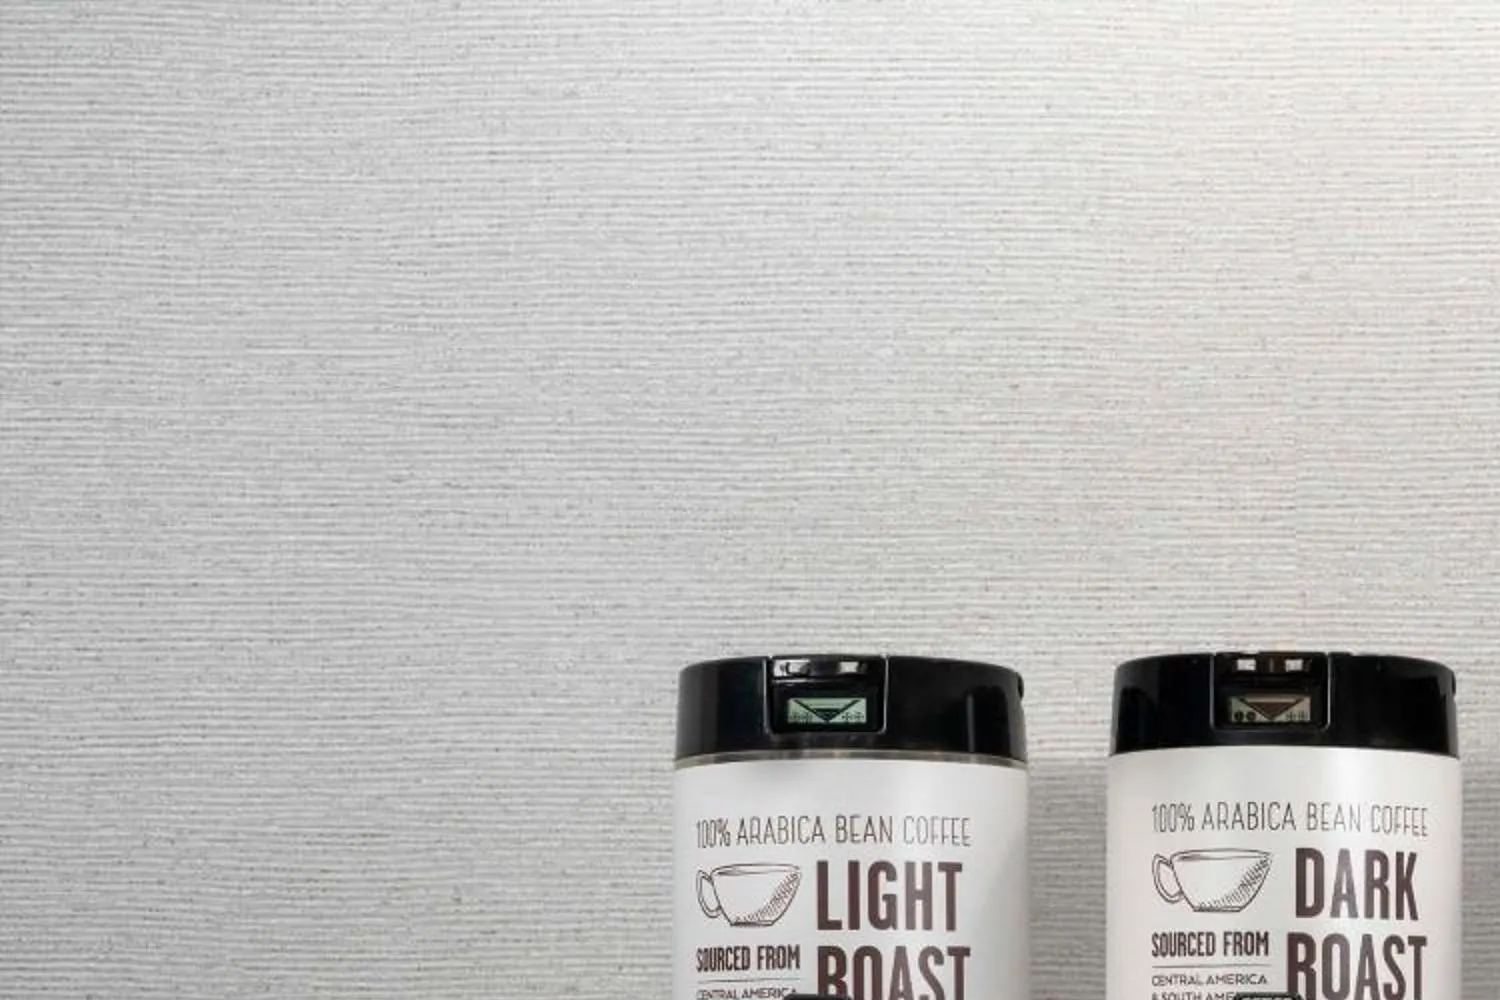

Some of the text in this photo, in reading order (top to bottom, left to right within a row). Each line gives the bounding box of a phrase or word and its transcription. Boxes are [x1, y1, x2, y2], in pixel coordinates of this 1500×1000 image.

[696, 814, 972, 849] 100% ARABICA BEAN COFFEE
[1152, 801, 1428, 836] 100% ARABICA BEAN COFFEE
[816, 860, 963, 932] LIGHT
[1296, 848, 1418, 920] DARK
[696, 944, 801, 972] SOURCED FROM
[1152, 931, 1269, 957] SOURCED FROM
[696, 988, 740, 1000] CENTRAL
[1152, 974, 1268, 986] CENTRAL AMERICA
